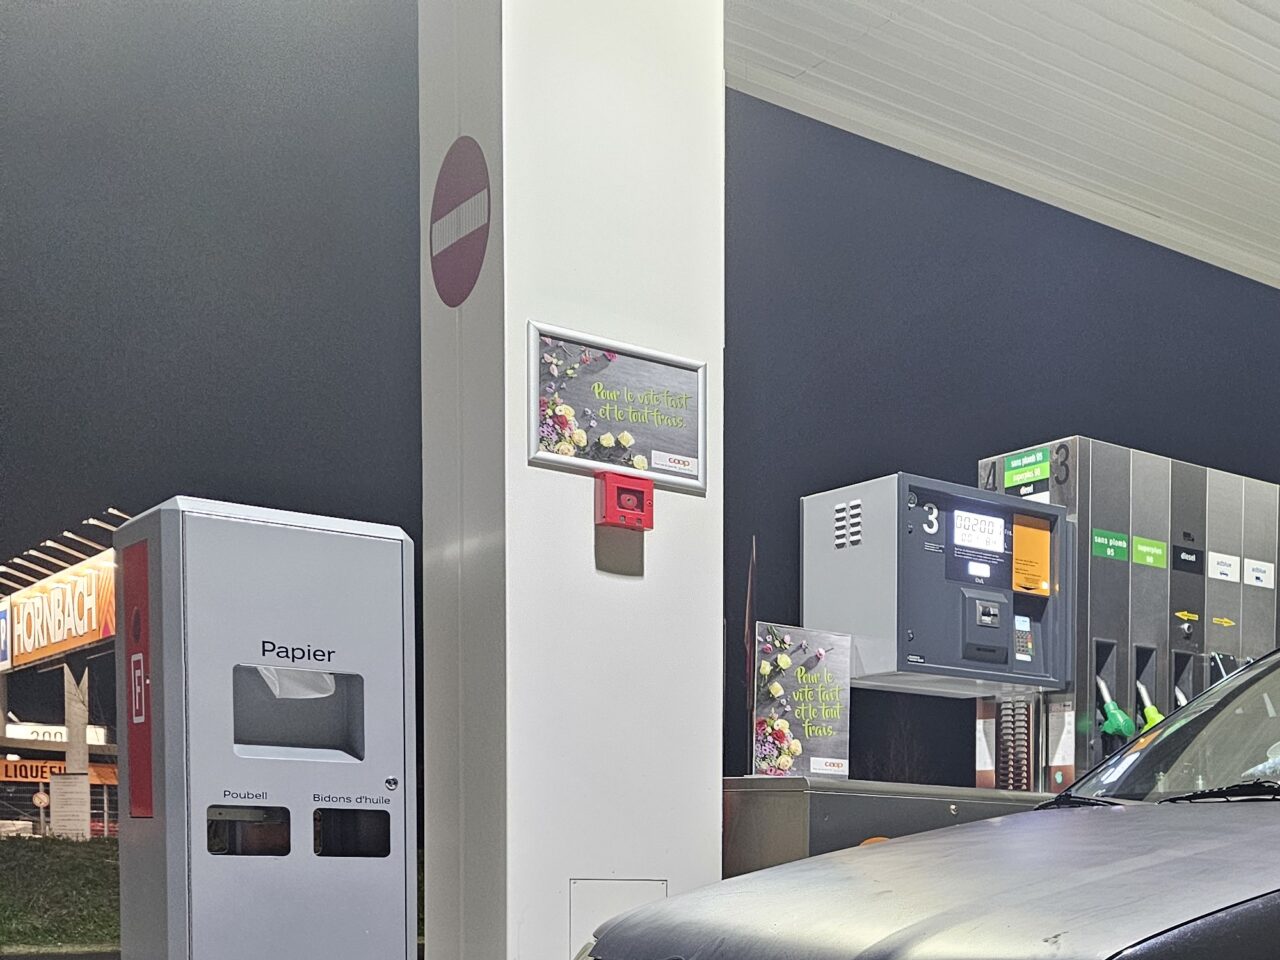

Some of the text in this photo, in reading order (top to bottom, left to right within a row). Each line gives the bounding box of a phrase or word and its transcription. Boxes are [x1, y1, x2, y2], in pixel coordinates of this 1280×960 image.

[591, 382, 692, 410] Pour le vite fait
[598, 403, 613, 420] et
[614, 404, 624, 421] le
[625, 405, 653, 424] tout
[1055, 443, 1070, 485] 3
[922, 502, 939, 535] 3
[1094, 536, 1127, 548] sans plomb
[13, 570, 97, 657] HORNBACH
[261, 640, 336, 663] Papier
[794, 665, 834, 683] Pour le
[792, 683, 843, 703] vite fait
[795, 702, 844, 720] et le tout
[802, 718, 837, 739] frais.
[223, 790, 268, 800] Poubell
[313, 794, 391, 805] Bidons d'huile
